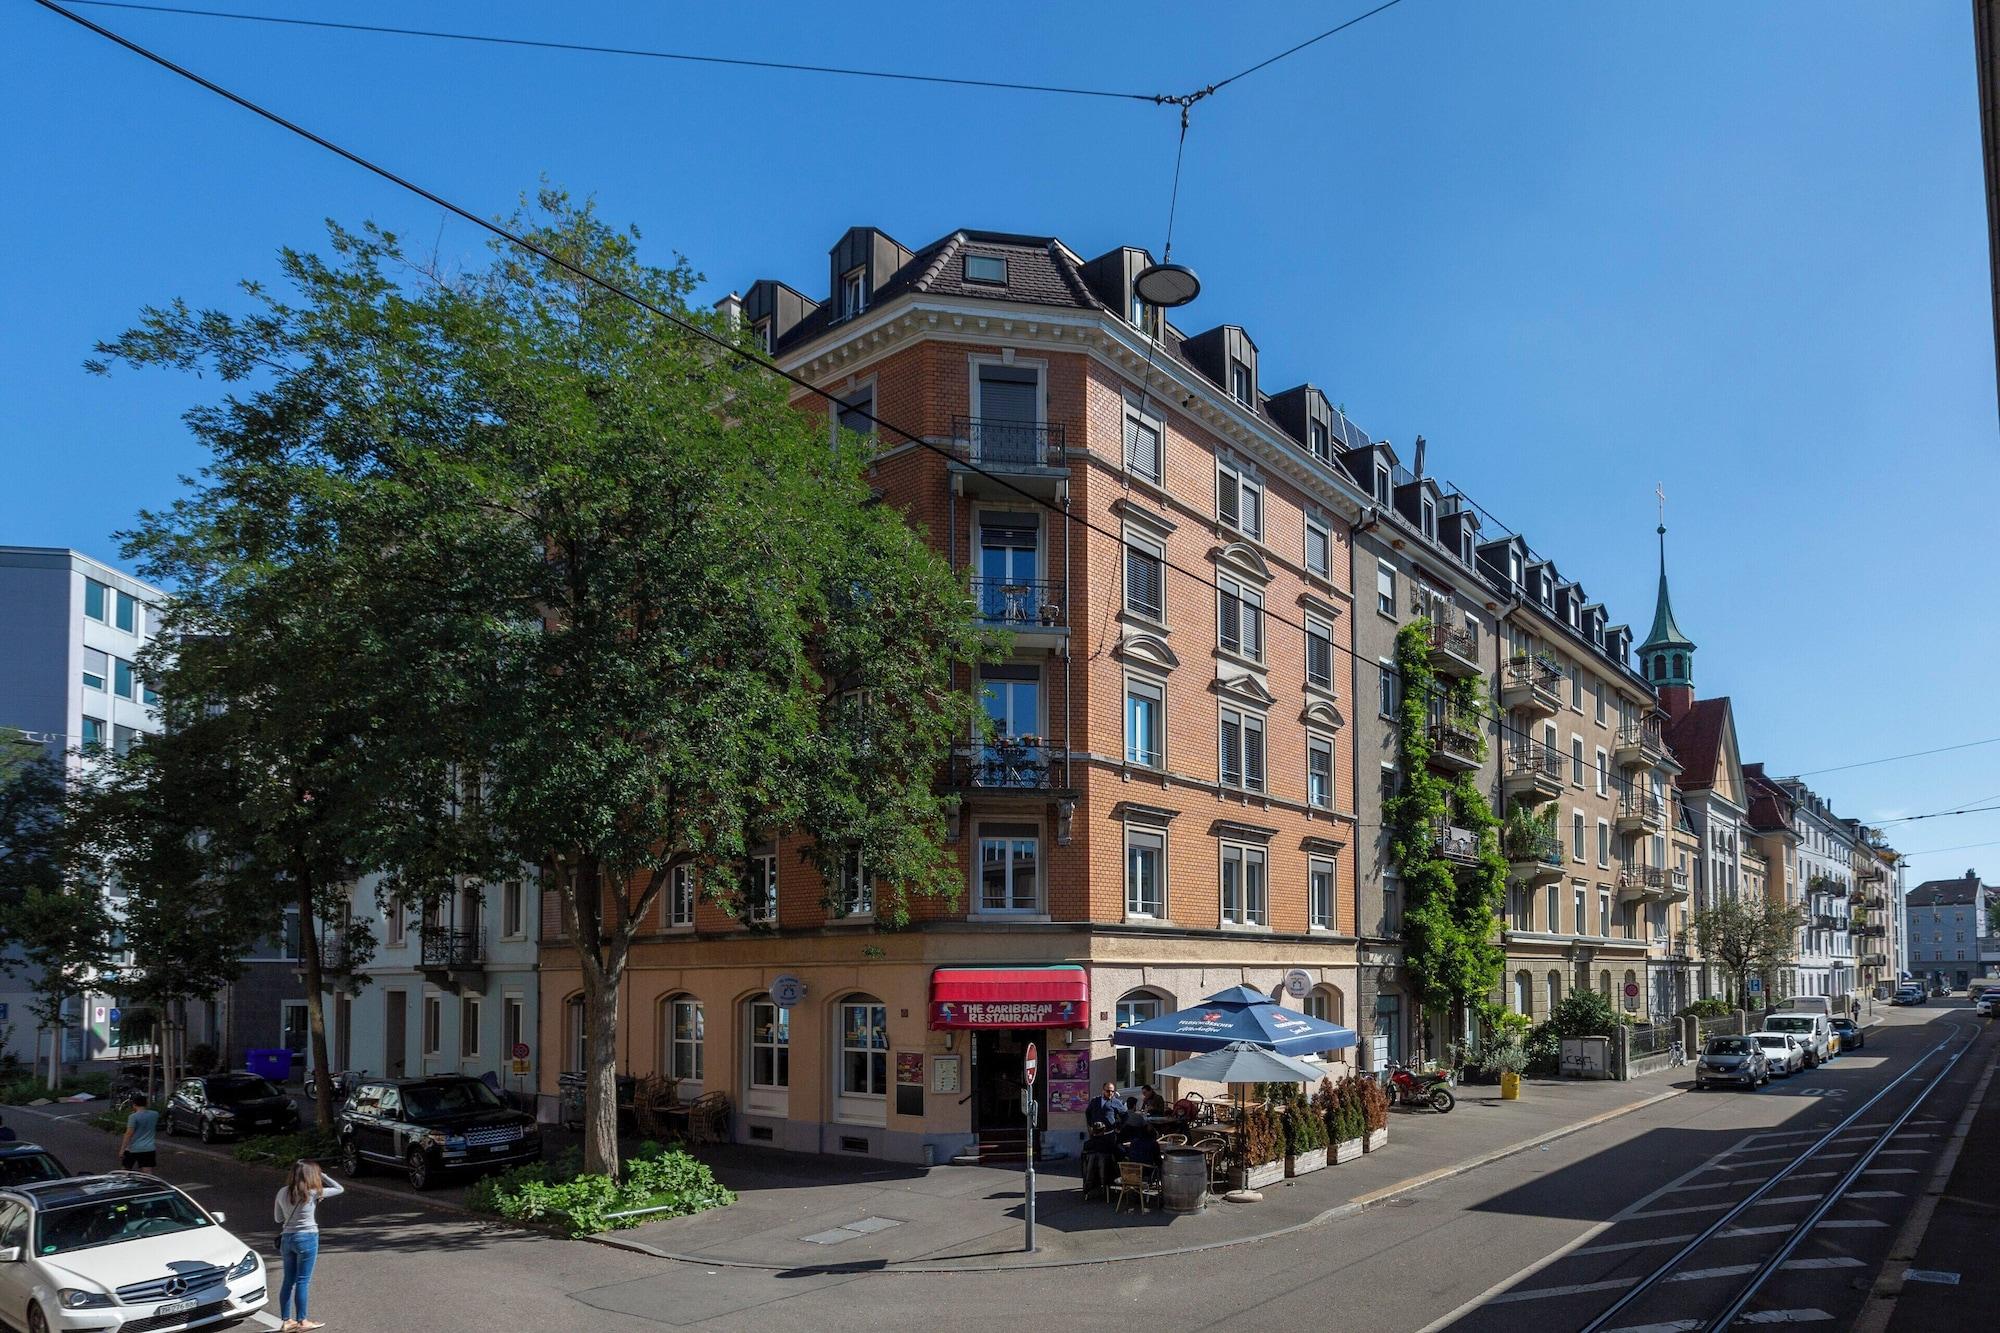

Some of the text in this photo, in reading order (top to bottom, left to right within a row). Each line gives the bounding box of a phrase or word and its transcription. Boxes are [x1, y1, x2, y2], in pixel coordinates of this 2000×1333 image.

[962, 1004, 1053, 1013] THE CARIBBEAN
[968, 1013, 1045, 1023] RESTAURANT
